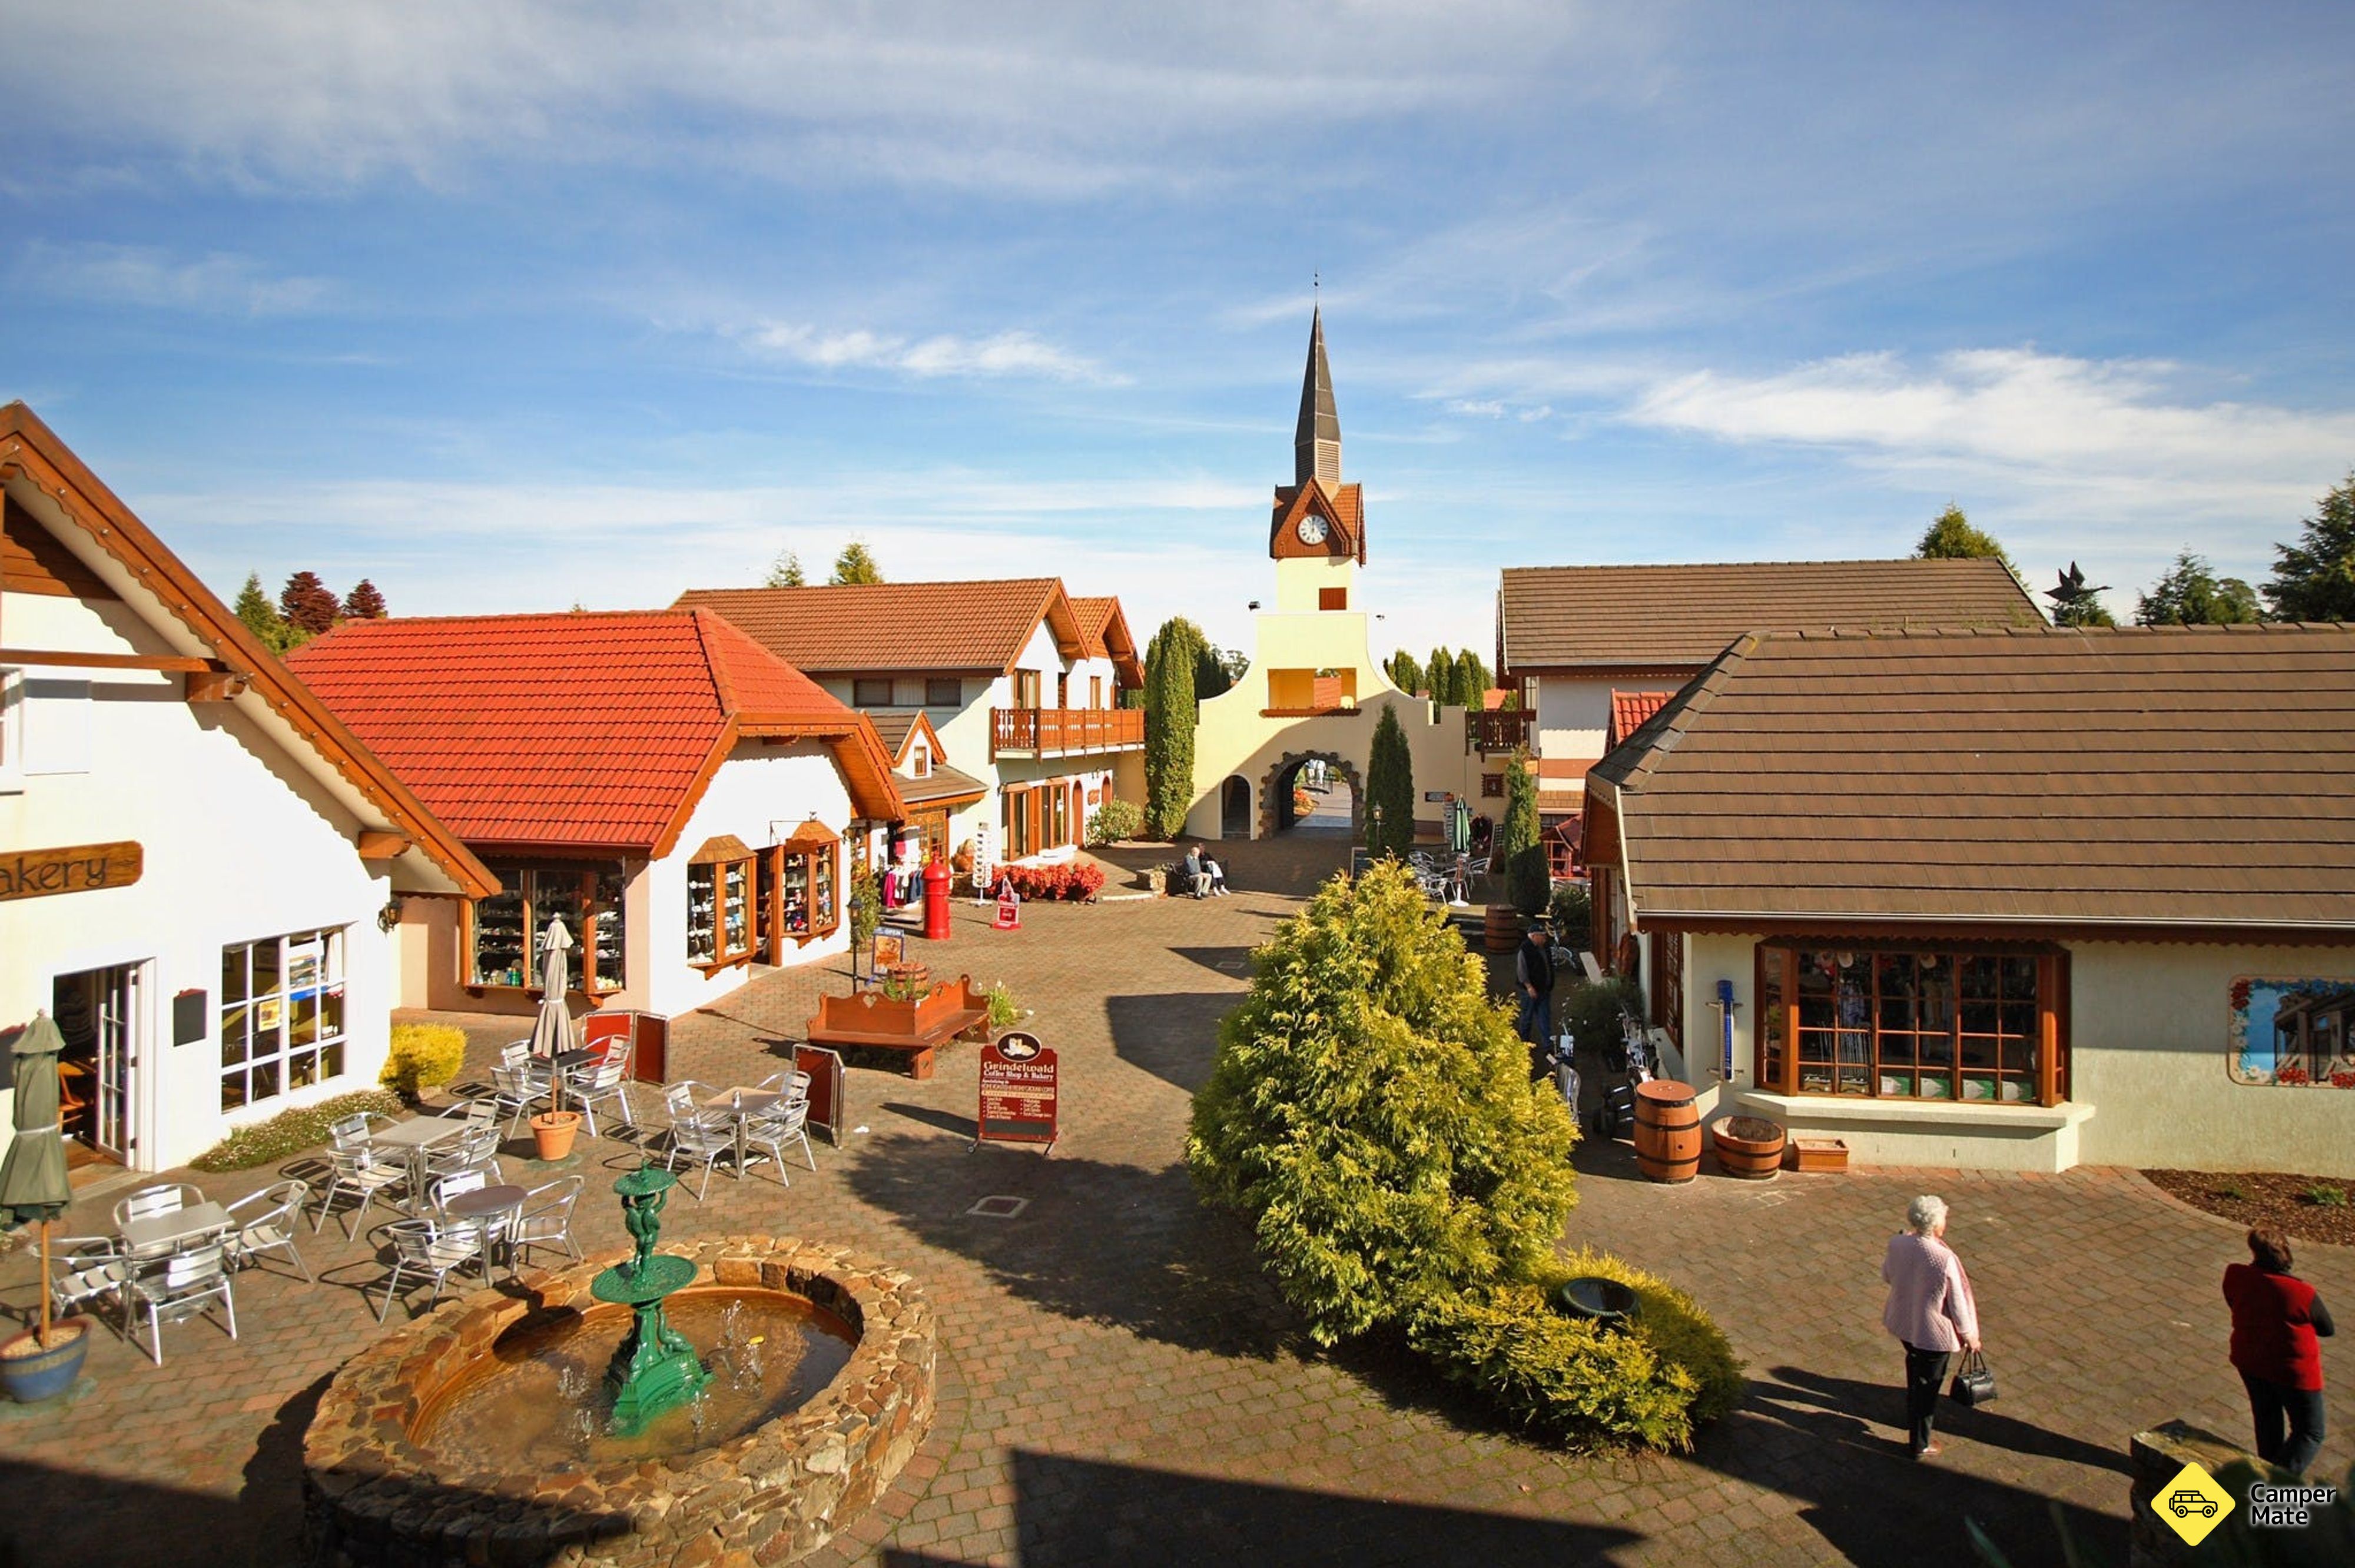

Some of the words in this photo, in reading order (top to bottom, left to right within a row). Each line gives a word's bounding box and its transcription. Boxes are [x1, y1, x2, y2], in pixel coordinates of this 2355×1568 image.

[984, 1061, 1054, 1073] Grindelwald
[984, 1068, 1004, 1077] Coffee
[1006, 1071, 1022, 1079] Shop
[1031, 1072, 1054, 1081] Bakery
